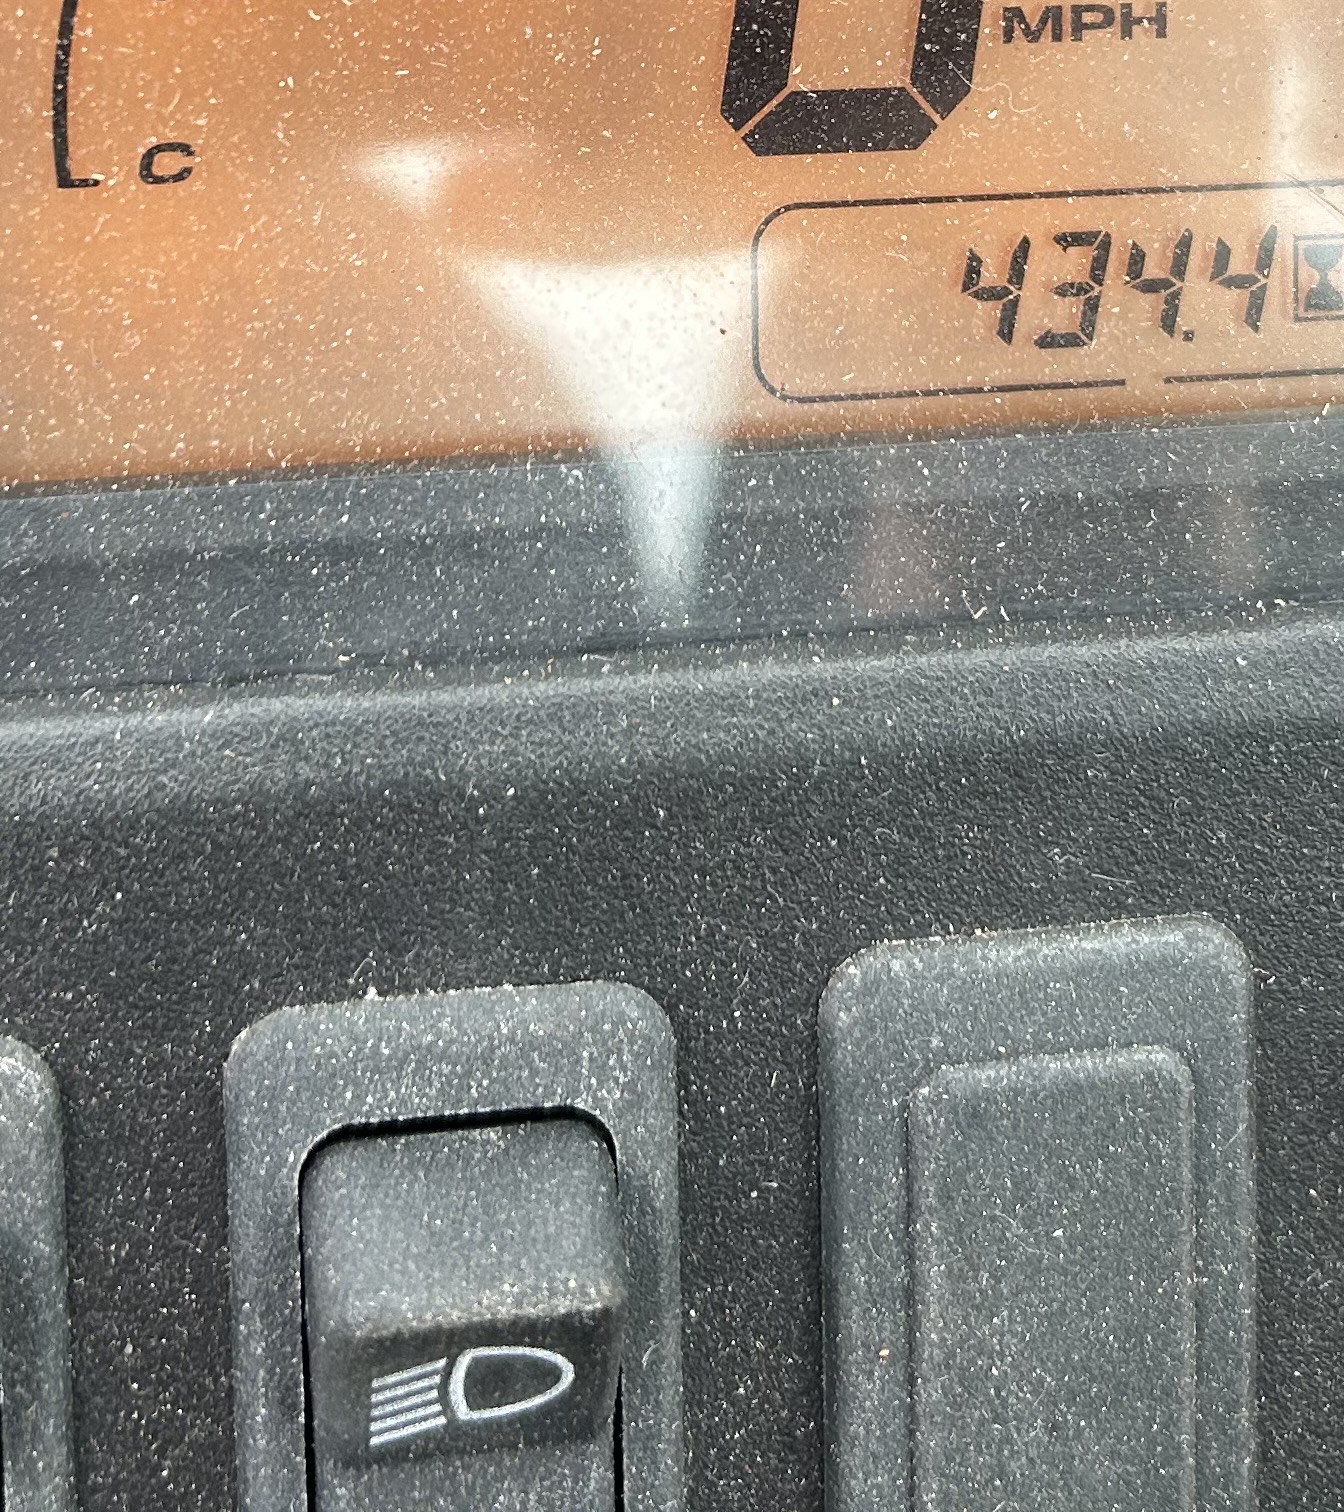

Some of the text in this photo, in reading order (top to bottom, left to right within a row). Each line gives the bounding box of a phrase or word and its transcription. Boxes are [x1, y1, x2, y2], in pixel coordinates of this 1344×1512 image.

[1001, 1, 1169, 45] MPH
[138, 141, 197, 185] C
[960, 223, 1279, 350] 434.4
